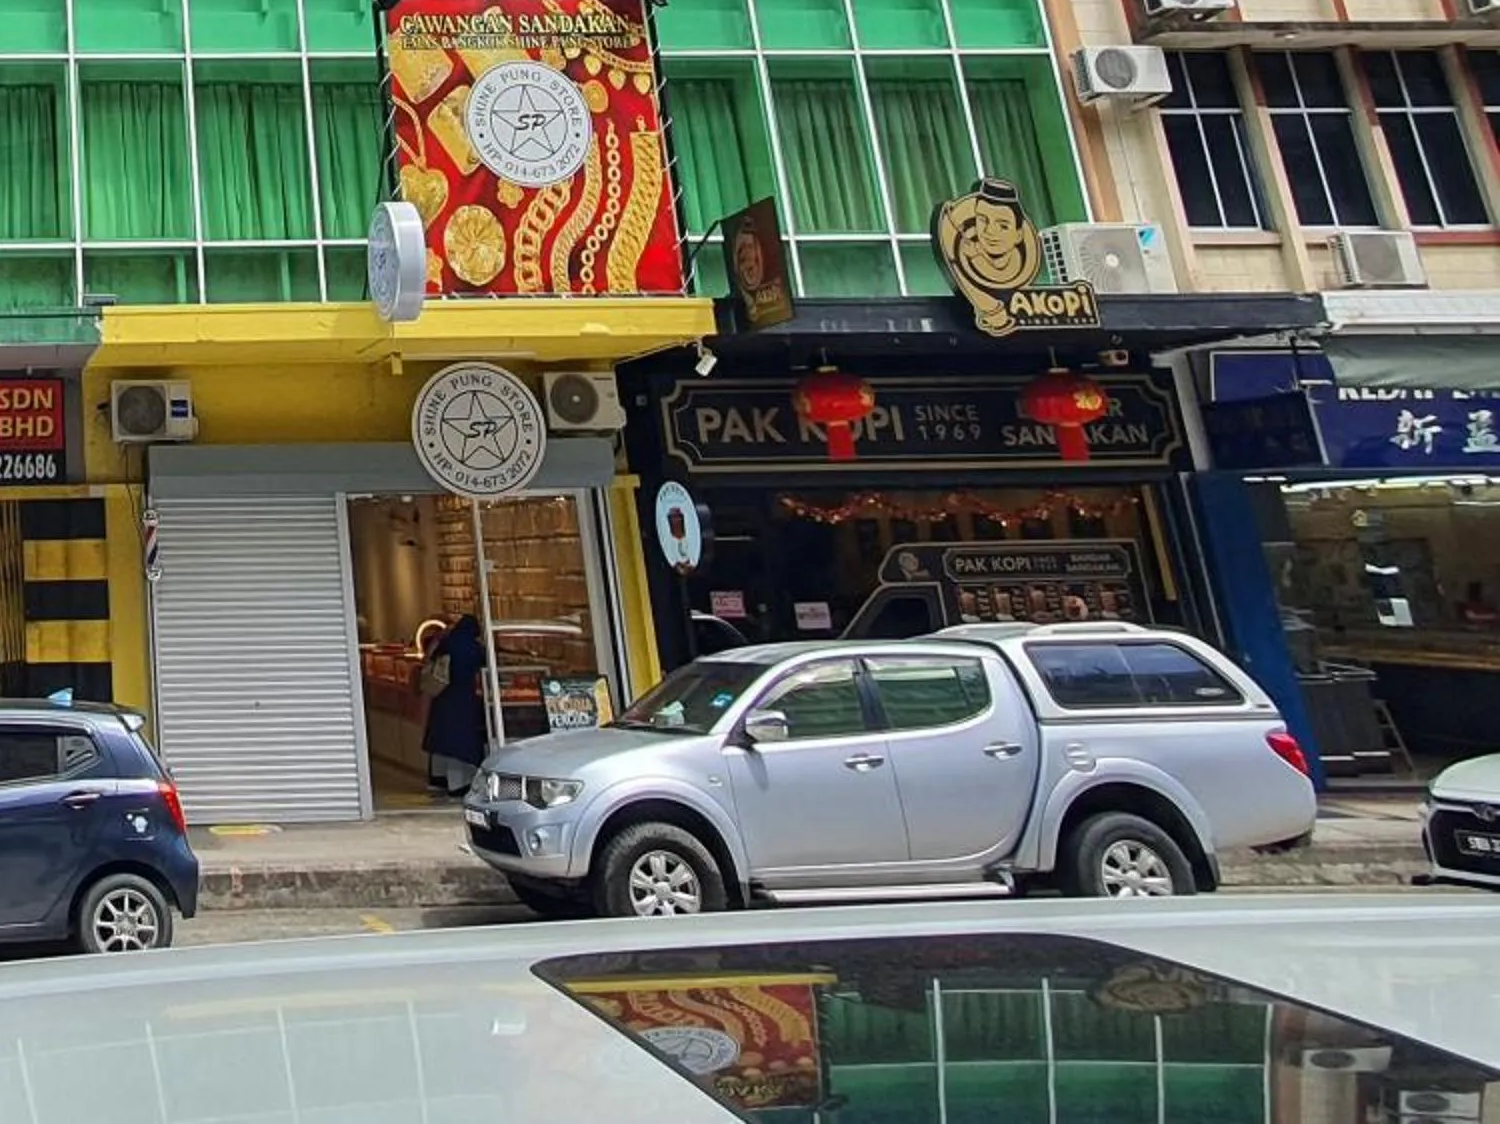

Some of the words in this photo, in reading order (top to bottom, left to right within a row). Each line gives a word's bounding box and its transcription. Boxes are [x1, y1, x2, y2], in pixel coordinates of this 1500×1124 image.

[518, 14, 631, 34] SANDAKAN
[475, 83, 498, 127] SHINE
[499, 69, 541, 84] PUNG
[549, 79, 582, 126] STORE
[515, 114, 547, 131] SP
[423, 389, 447, 437] SHINE
[449, 374, 493, 390] PUNG
[500, 385, 533, 433] STORE
[914, 404, 980, 422] SINCE
[466, 421, 498, 439] SP
[694, 407, 787, 444] PAK
[798, 405, 905, 443] KPI
[916, 424, 982, 441] 1969
[955, 556, 989, 573] PAK
[991, 555, 1032, 573] KOPI
